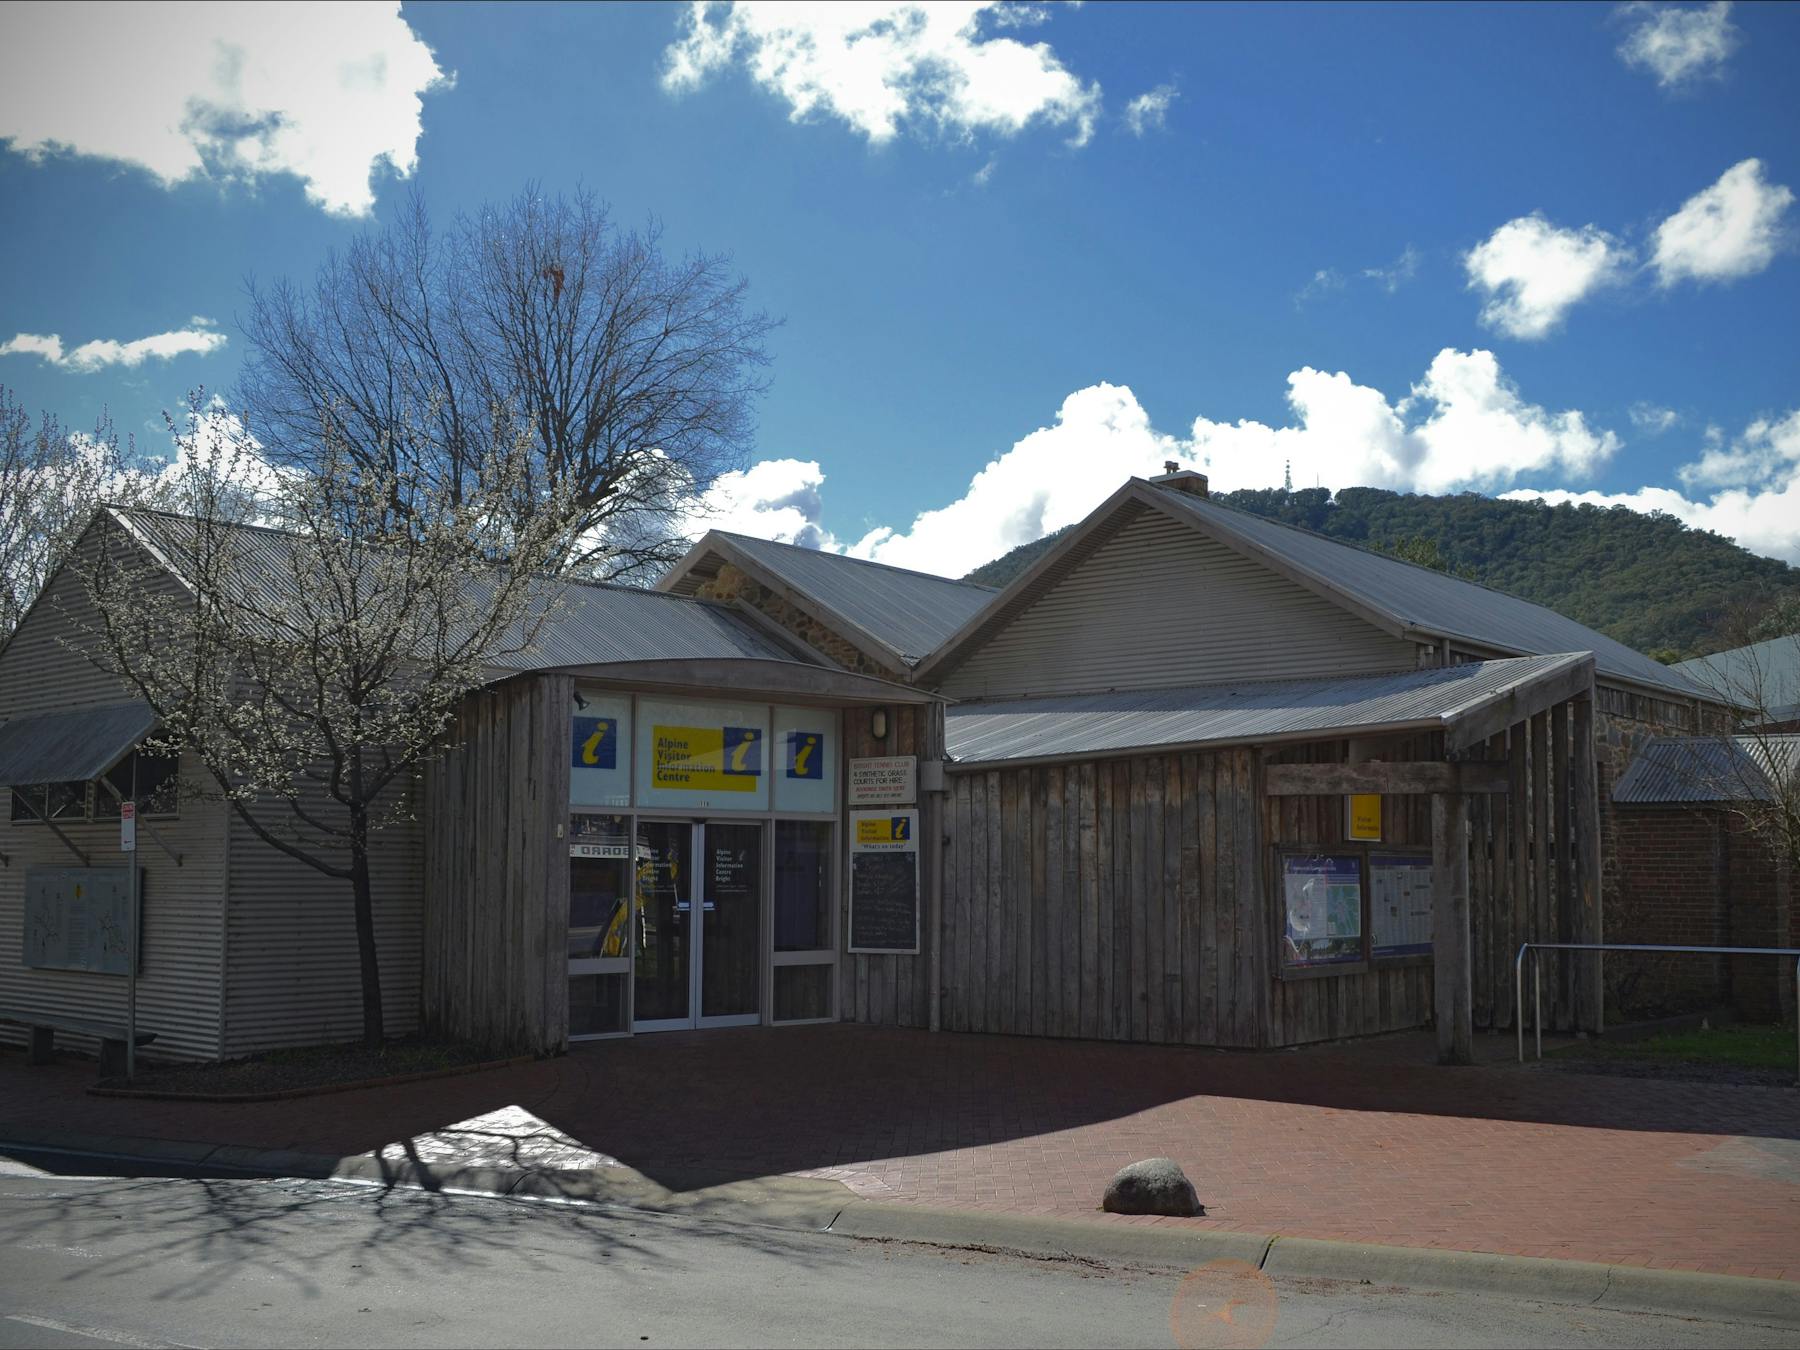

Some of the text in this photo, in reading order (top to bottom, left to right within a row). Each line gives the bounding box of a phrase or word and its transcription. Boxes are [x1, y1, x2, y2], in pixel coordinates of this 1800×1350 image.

[657, 737, 688, 750] Alpine
[657, 750, 691, 760] Visitor
[657, 760, 715, 773] Information
[894, 760, 910, 768] CLUB
[657, 770, 690, 782] Centre
[859, 770, 886, 778] SYNTHETIC
[887, 769, 907, 777] GRASS
[853, 777, 875, 785] COURTS
[716, 848, 731, 856] Alpine
